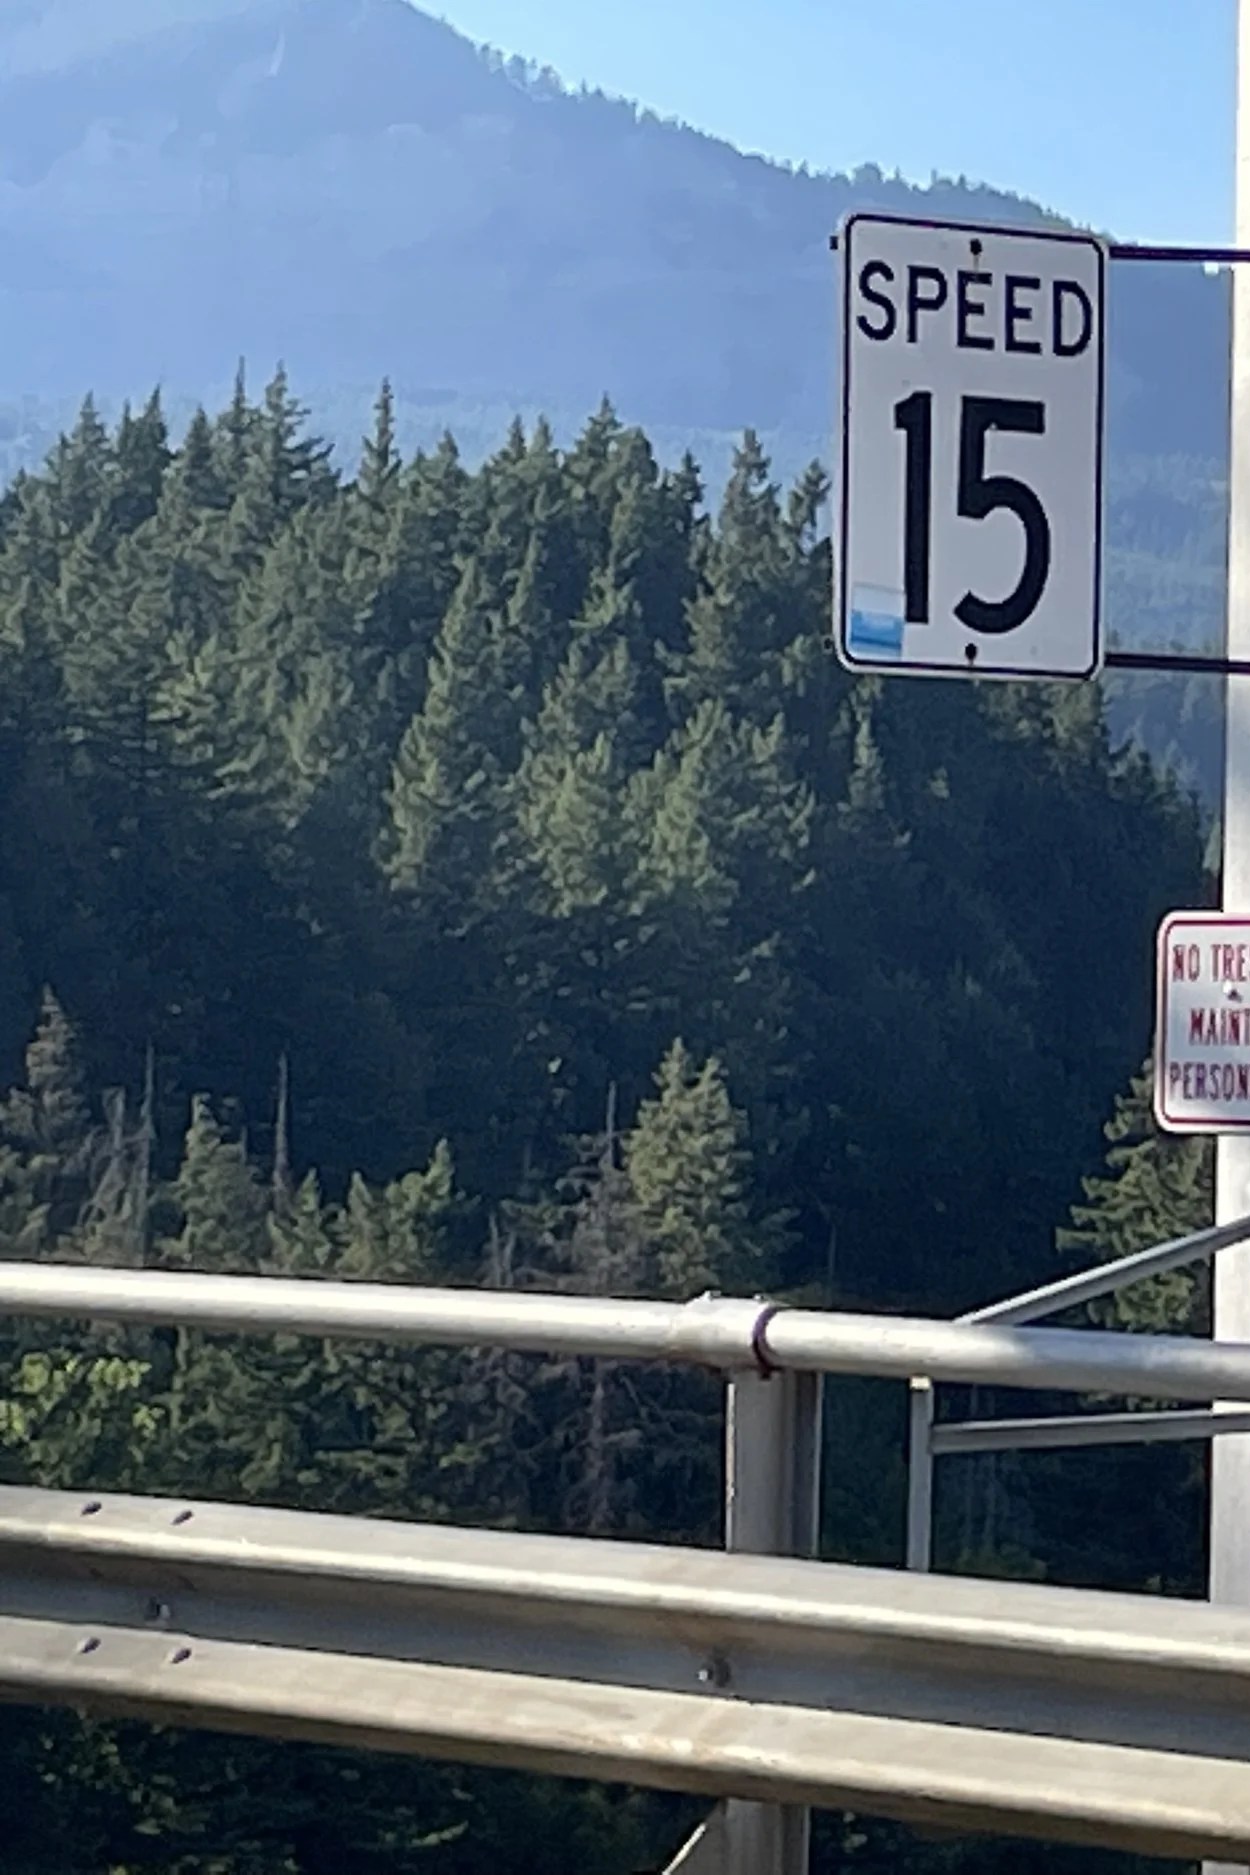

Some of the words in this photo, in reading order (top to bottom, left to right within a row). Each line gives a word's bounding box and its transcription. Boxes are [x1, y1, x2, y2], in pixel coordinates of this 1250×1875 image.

[857, 260, 1093, 357] SPEED
[894, 390, 1051, 634] 15
[1172, 944, 1200, 982] NO
